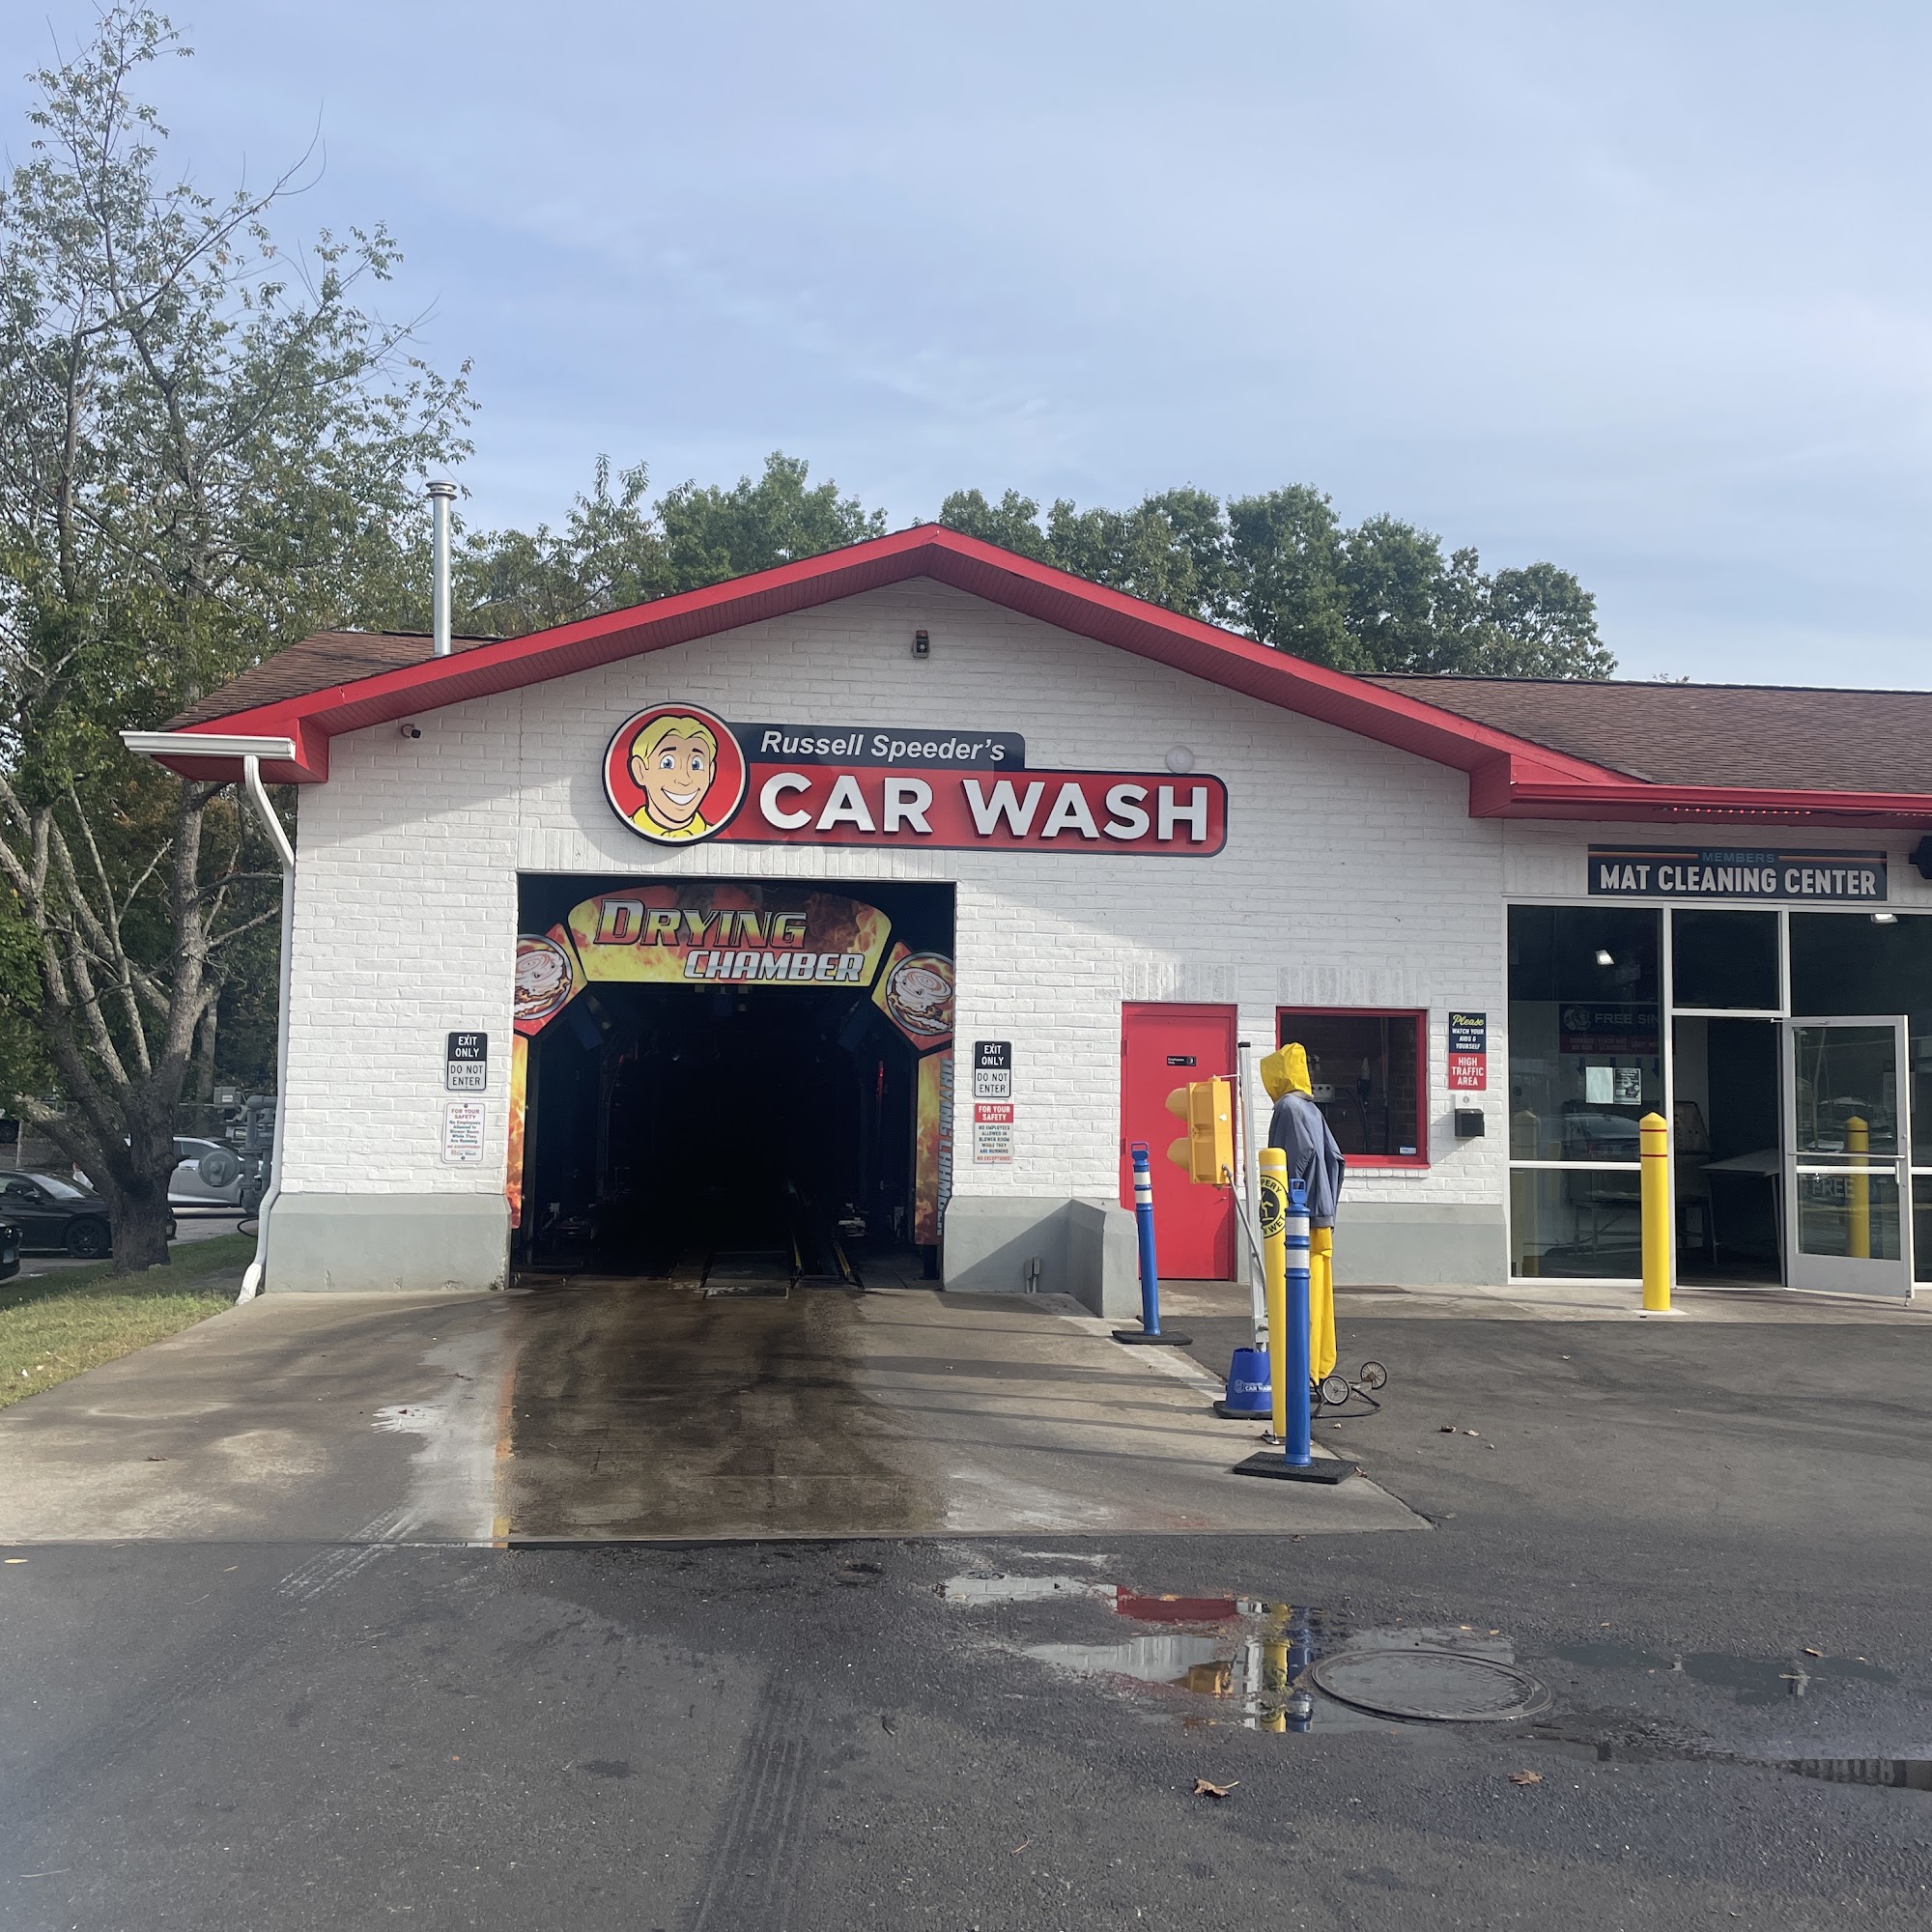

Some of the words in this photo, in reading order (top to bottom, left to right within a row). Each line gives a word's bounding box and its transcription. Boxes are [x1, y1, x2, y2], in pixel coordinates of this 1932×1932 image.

[760, 730, 864, 757] Russell
[870, 734, 1006, 762] Speeder's
[759, 773, 934, 835] CAR
[962, 779, 1208, 843] WASH
[1702, 852, 1776, 864] MEMBERS
[1600, 865, 1651, 890] MAT
[1658, 865, 1777, 894] CLEANING
[1784, 868, 1877, 895] CENTER
[593, 897, 808, 950] DRYING
[683, 950, 866, 982] CHAMBER
[1452, 1014, 1484, 1026] Please
[1594, 1012, 1633, 1024] FREE
[1637, 1013, 1659, 1025] SIN
[458, 1036, 478, 1046] EXIT
[455, 1048, 480, 1058] ONLY
[984, 1045, 1002, 1054] EXIT
[981, 1056, 1004, 1065] ONLY
[1458, 1057, 1477, 1066] HIGH
[451, 1065, 463, 1074] DO
[466, 1065, 483, 1074] NOT
[1452, 1066, 1484, 1076] TRAFFIC
[452, 1077, 481, 1086] ENTER
[977, 1073, 988, 1082] DO
[992, 1073, 1008, 1082] NOT
[1457, 1077, 1478, 1086] AREA
[979, 1084, 1006, 1093] ENTER
[1261, 1179, 1282, 1193] PERY
[1268, 1215, 1285, 1232] WET
